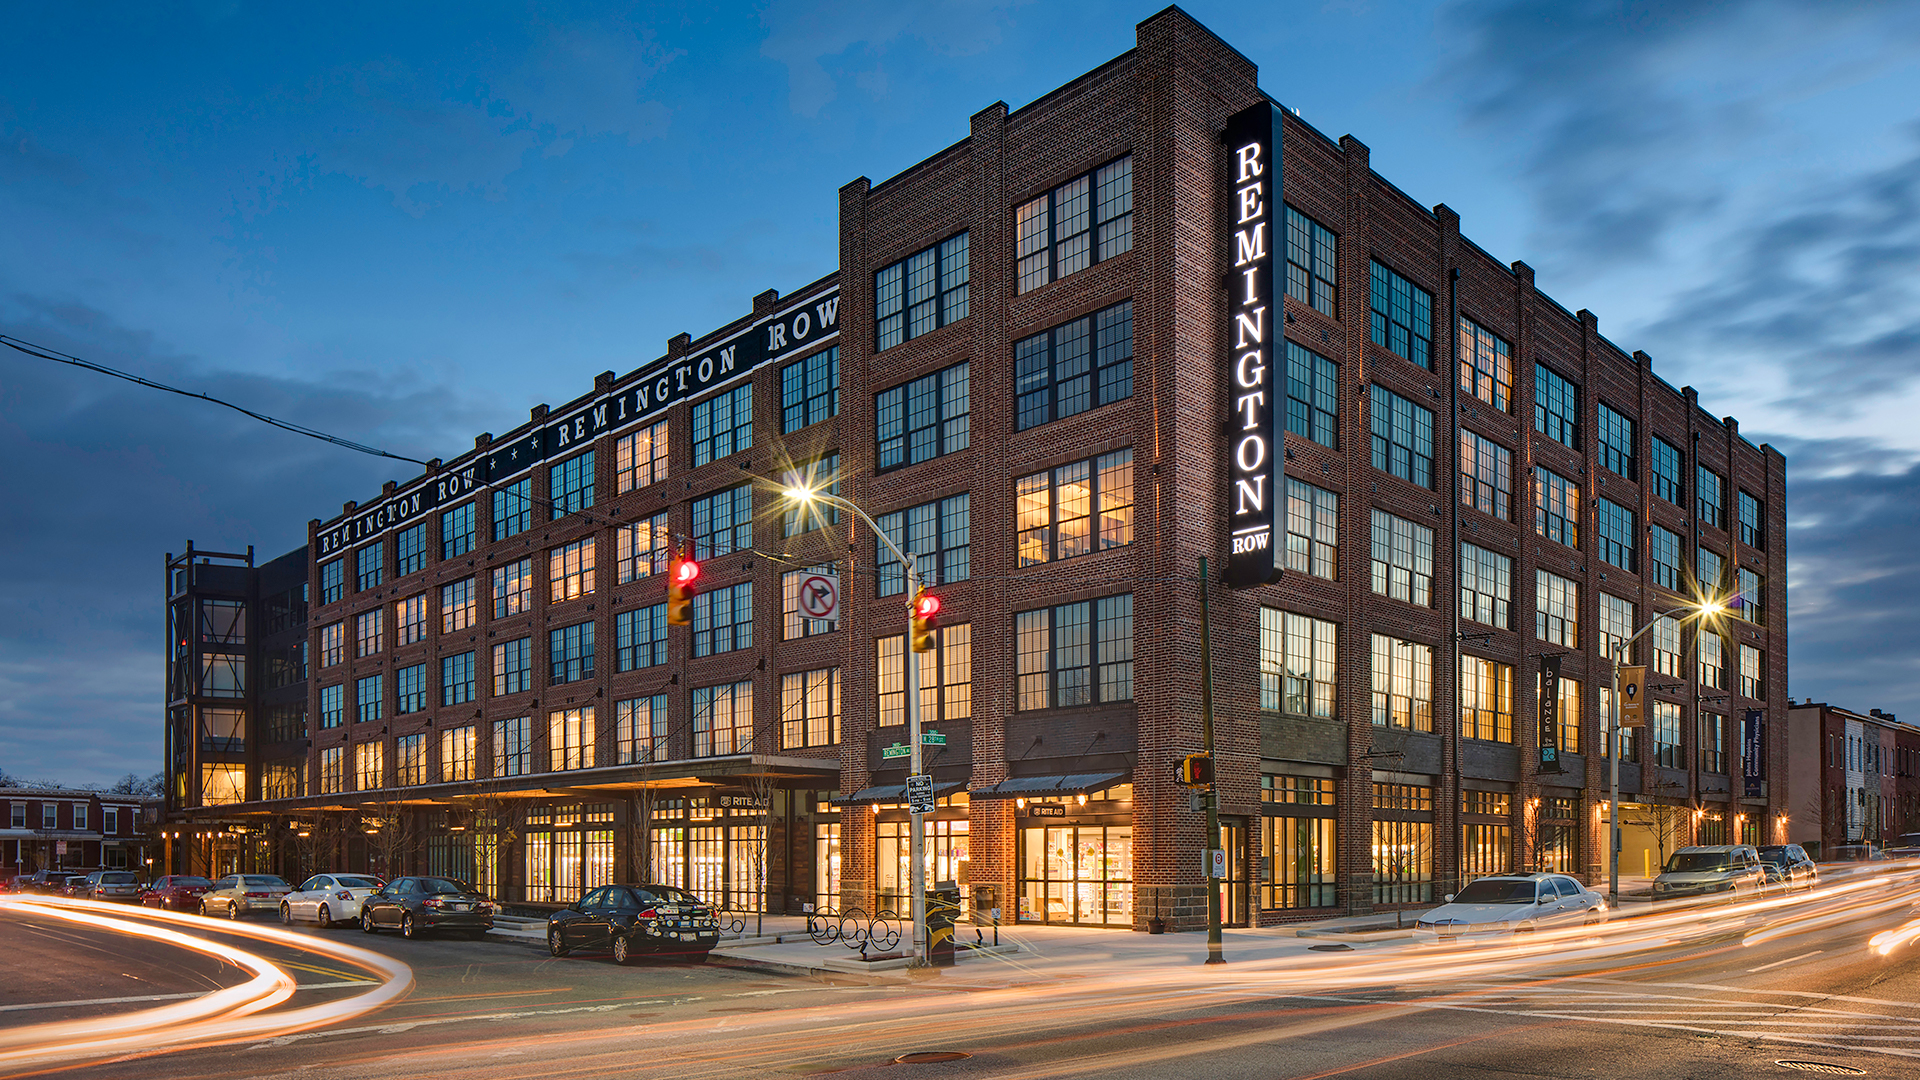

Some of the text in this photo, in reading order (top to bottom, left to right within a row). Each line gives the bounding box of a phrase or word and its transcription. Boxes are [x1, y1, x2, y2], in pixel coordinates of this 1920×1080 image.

[1233, 141, 1267, 515] REMINGTON
[557, 295, 841, 448] REMINGTON ROW
[322, 467, 476, 554] REMINGTON ROW
[1231, 531, 1271, 555] ROW
[1752, 715, 1761, 744] Physicians
[1752, 743, 1760, 777] Community
[733, 796, 752, 806] RITE
[909, 785, 931, 793] PARKING
[1041, 807, 1064, 816] RITE AID
